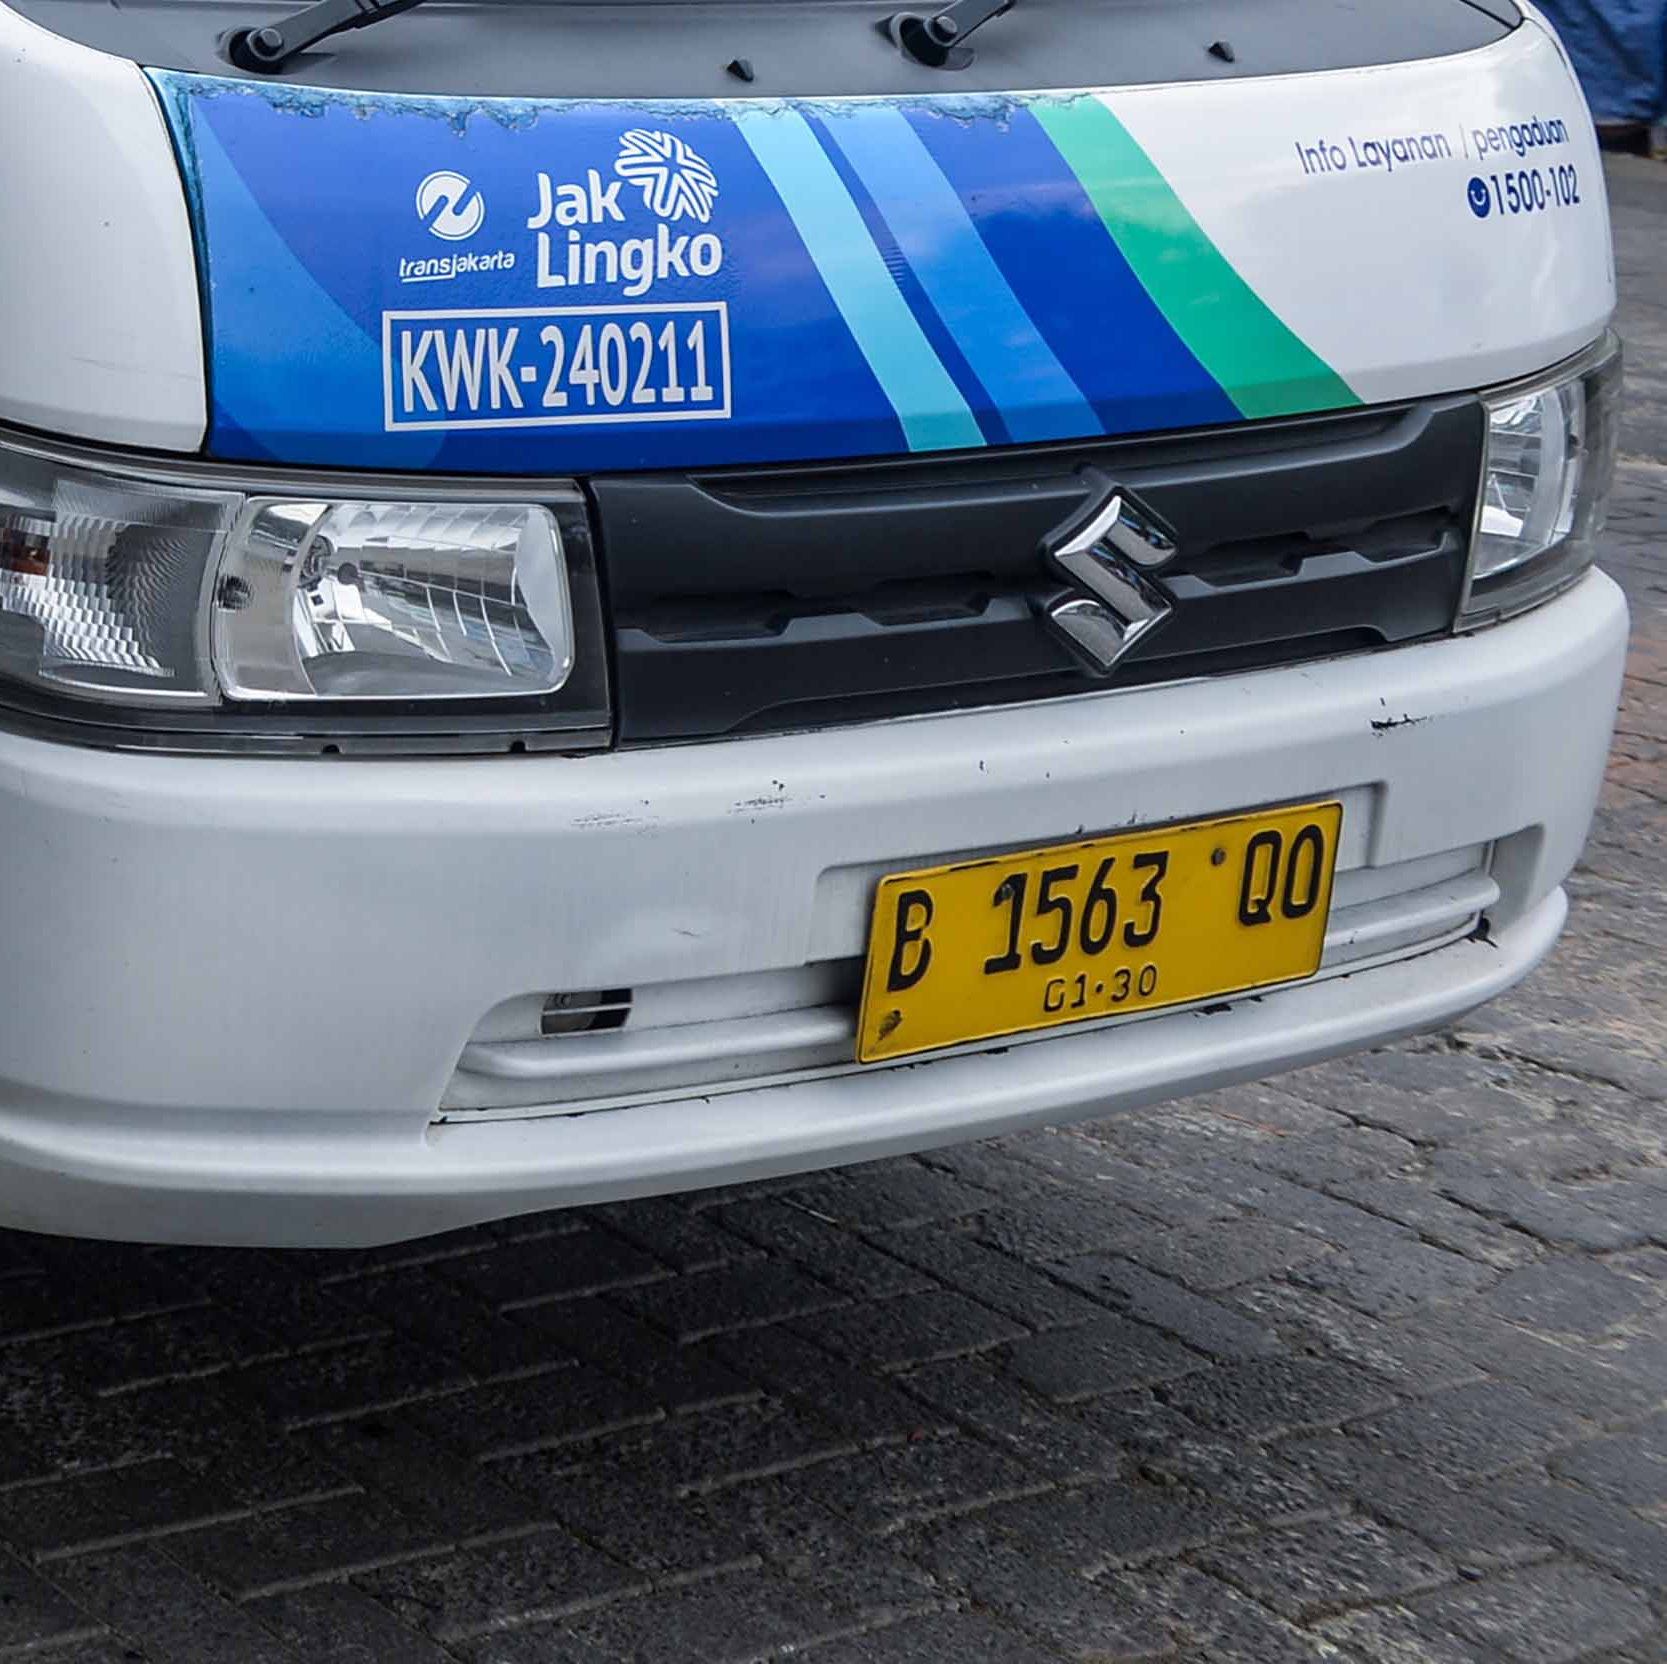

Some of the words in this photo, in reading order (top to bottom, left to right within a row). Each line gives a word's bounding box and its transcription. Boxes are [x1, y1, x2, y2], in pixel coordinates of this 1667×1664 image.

[1294, 140, 1348, 175] Info
[1348, 130, 1453, 173] Layanan
[1473, 115, 1570, 161] pengaduan
[526, 168, 626, 229] Jak
[1490, 163, 1581, 216] 1500-102
[398, 249, 516, 284] transjakarta
[536, 222, 724, 297] Lingko
[400, 319, 715, 414] KWK-240211
[886, 888, 936, 993] B
[983, 850, 1171, 976] 1563
